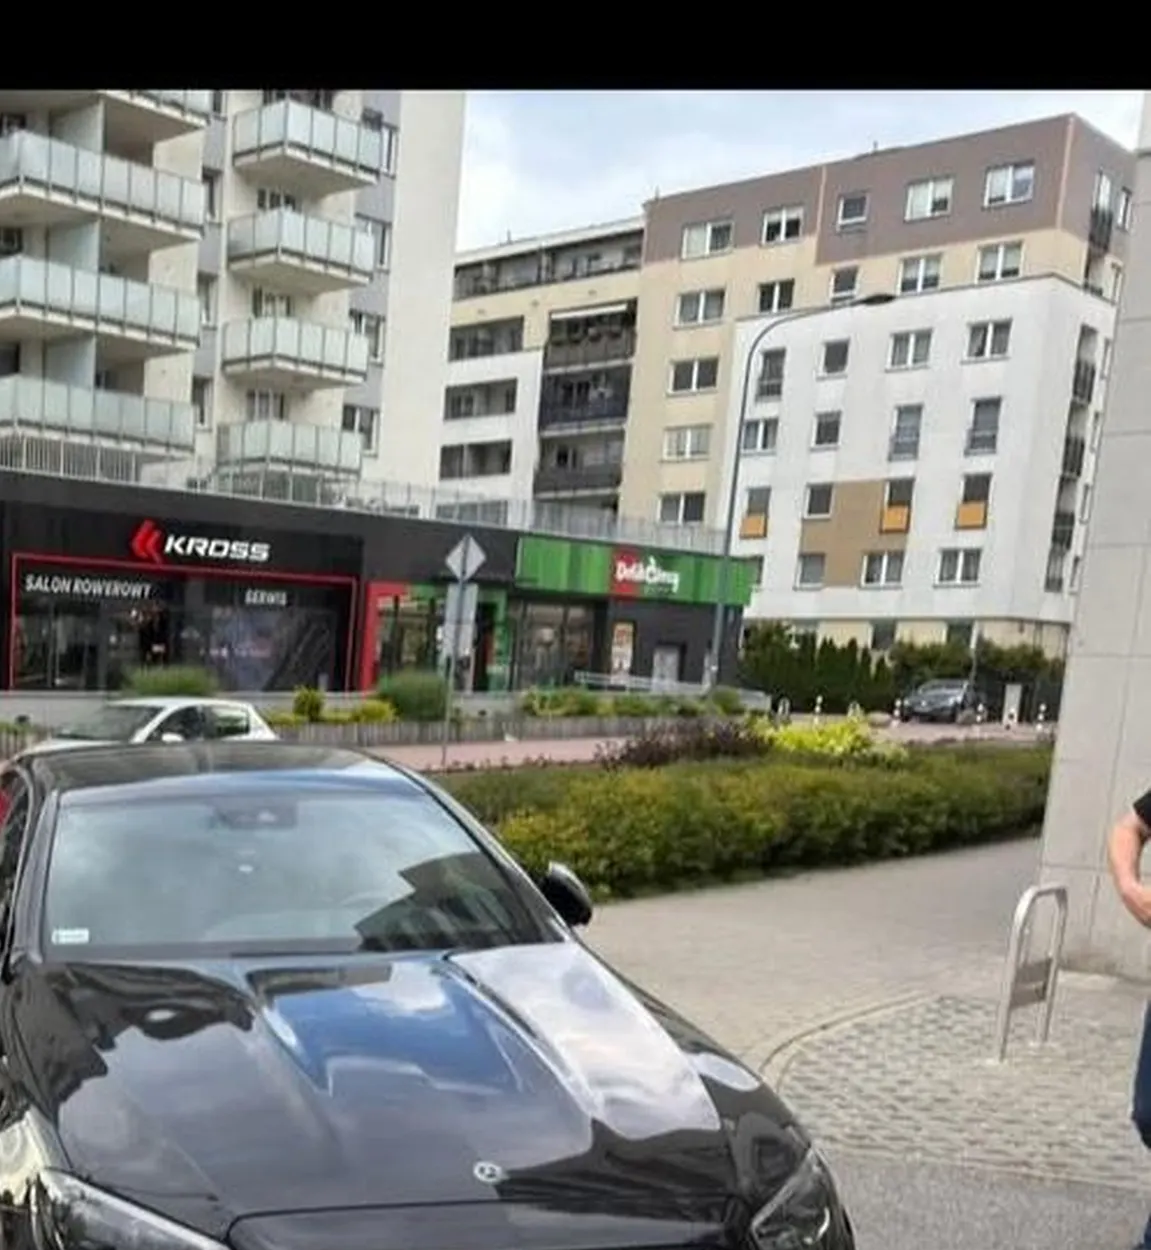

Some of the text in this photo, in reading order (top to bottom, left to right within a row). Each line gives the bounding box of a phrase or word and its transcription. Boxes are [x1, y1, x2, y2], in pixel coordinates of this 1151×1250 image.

[164, 534, 270, 562] KROSS
[25, 574, 151, 599] SALON ROWEROWY
